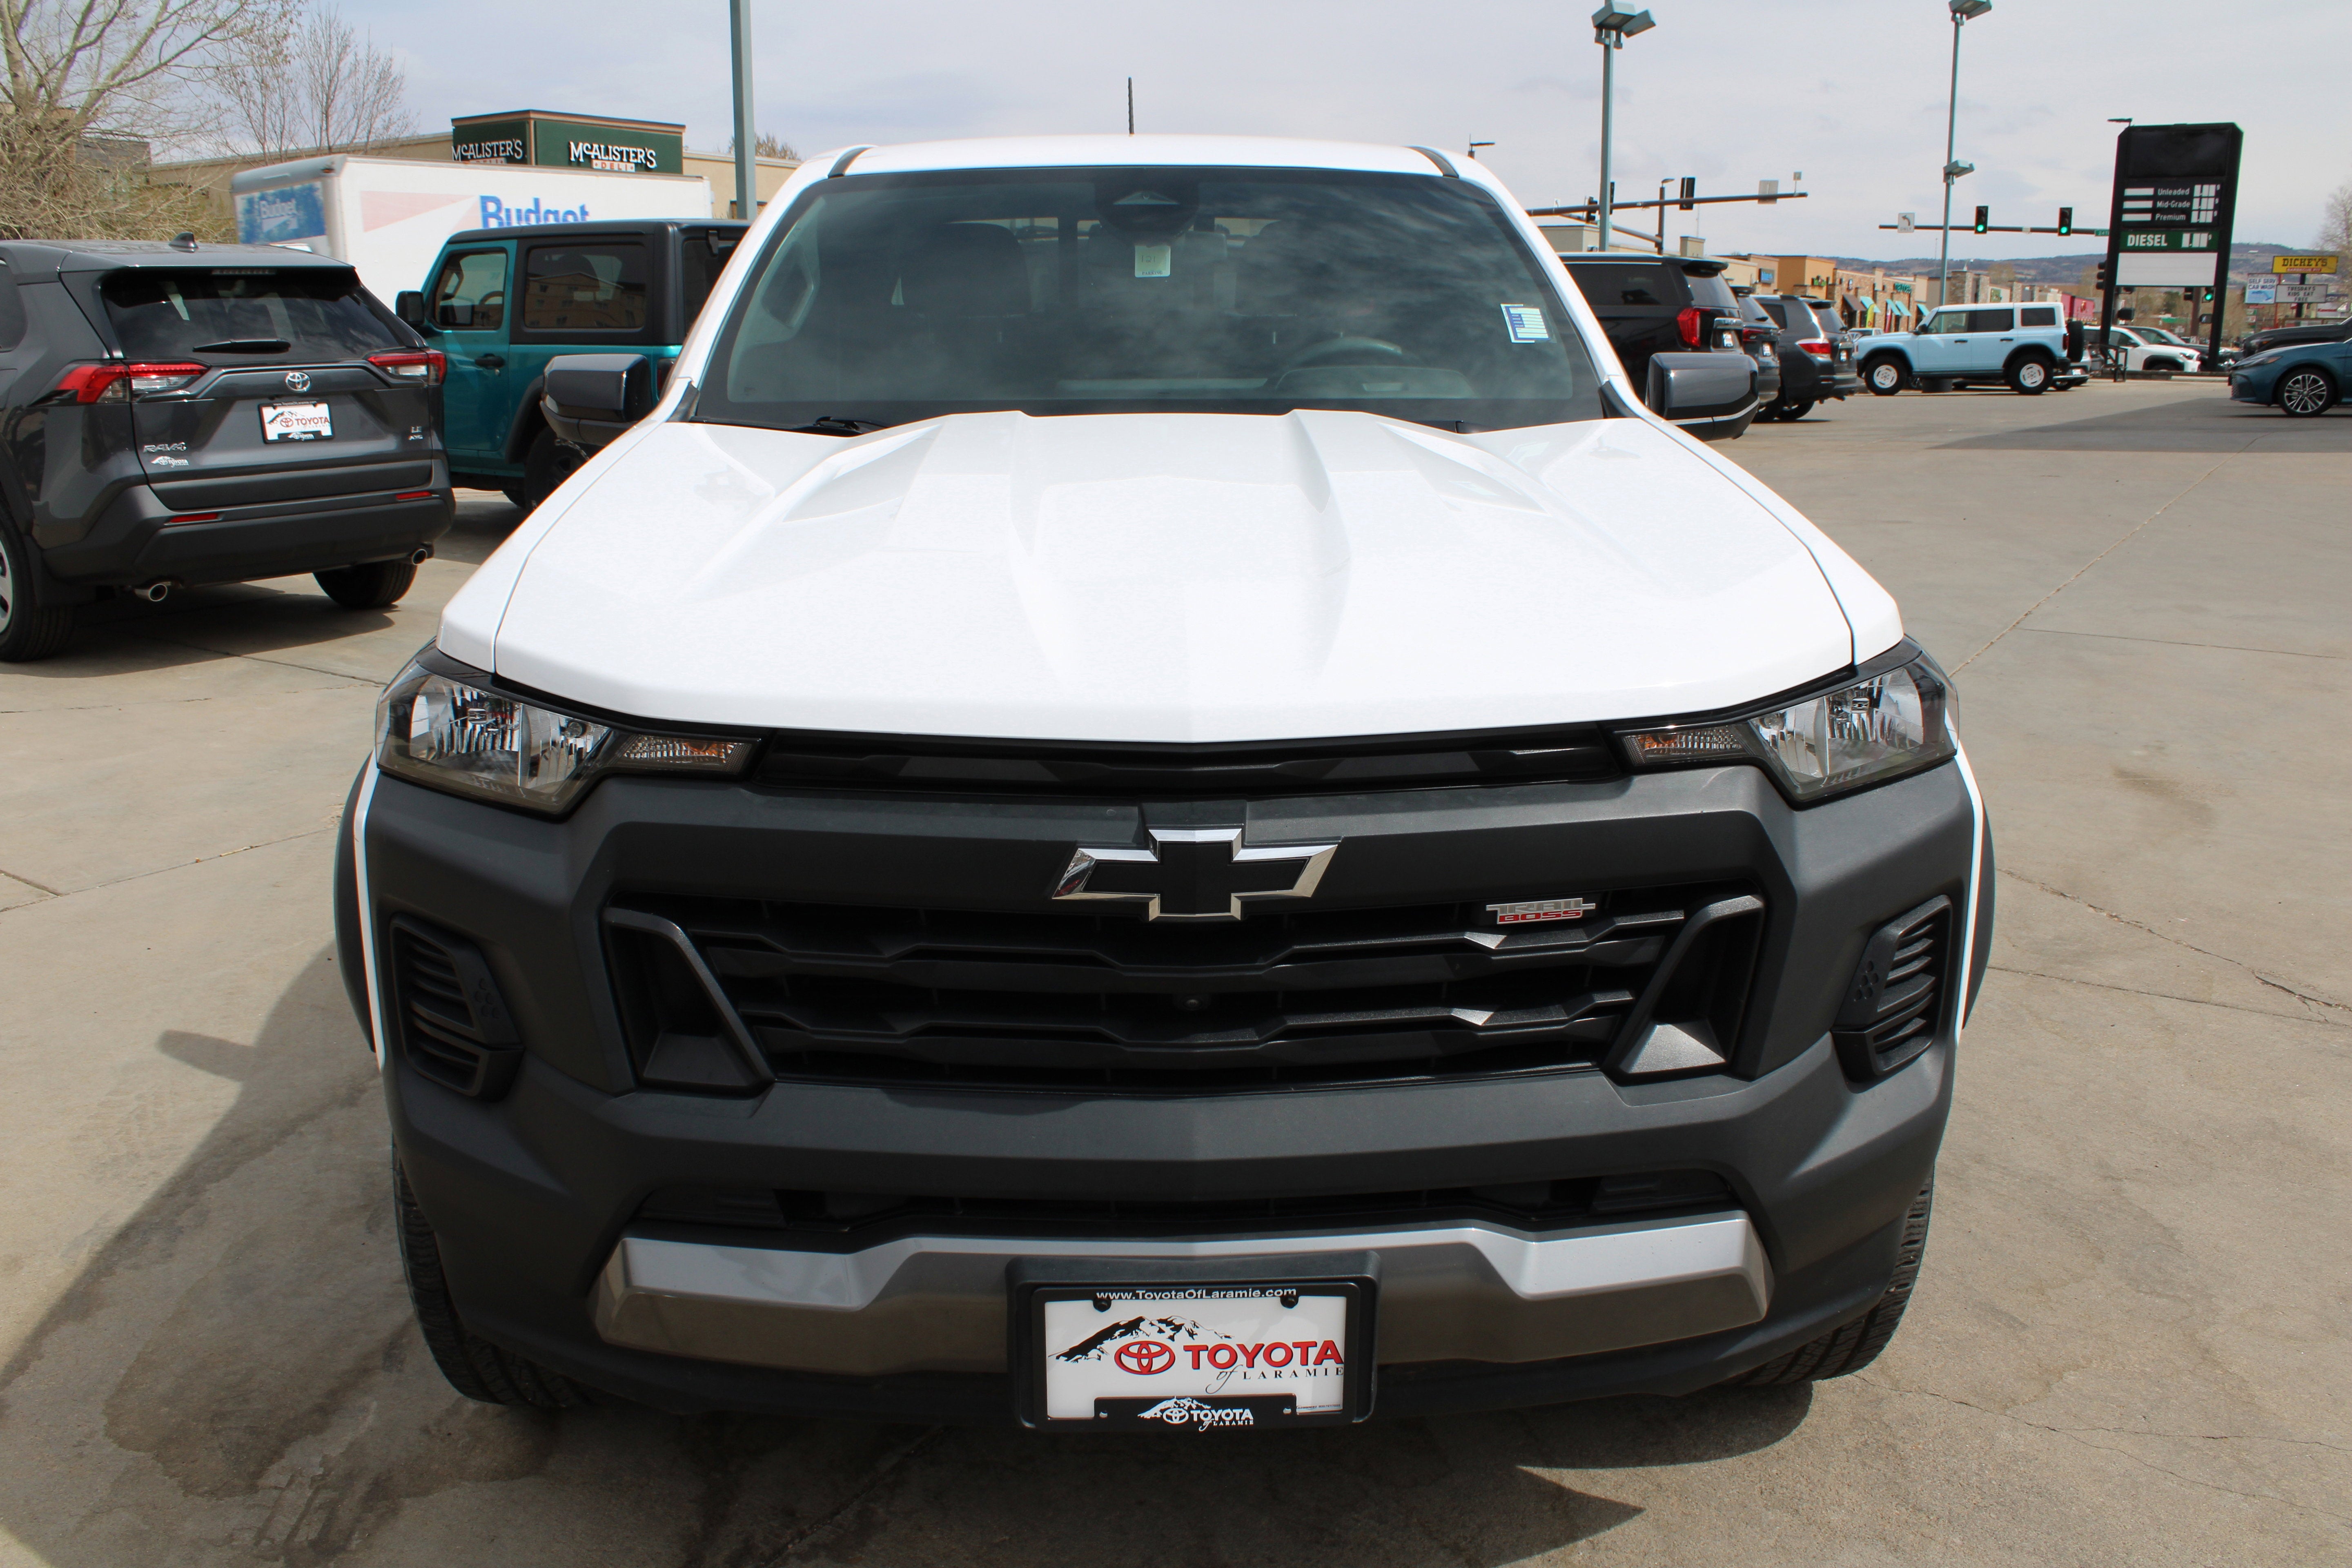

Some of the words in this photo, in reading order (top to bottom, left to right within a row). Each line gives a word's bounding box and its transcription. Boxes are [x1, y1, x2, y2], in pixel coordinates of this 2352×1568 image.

[2127, 234, 2167, 247] DIESEL
[295, 416, 330, 425] TOYOTA
[143, 442, 187, 452] RAV4
[1487, 898, 1595, 915] TRAIL
[1499, 909, 1581, 923] BOSS
[1096, 1287, 1296, 1301] www.ToyotaOfLaramie.com
[1183, 1340, 1344, 1370] TOYOTA
[1243, 1367, 1344, 1380] LARAMIE
[1190, 1409, 1254, 1421] TOYOTA
